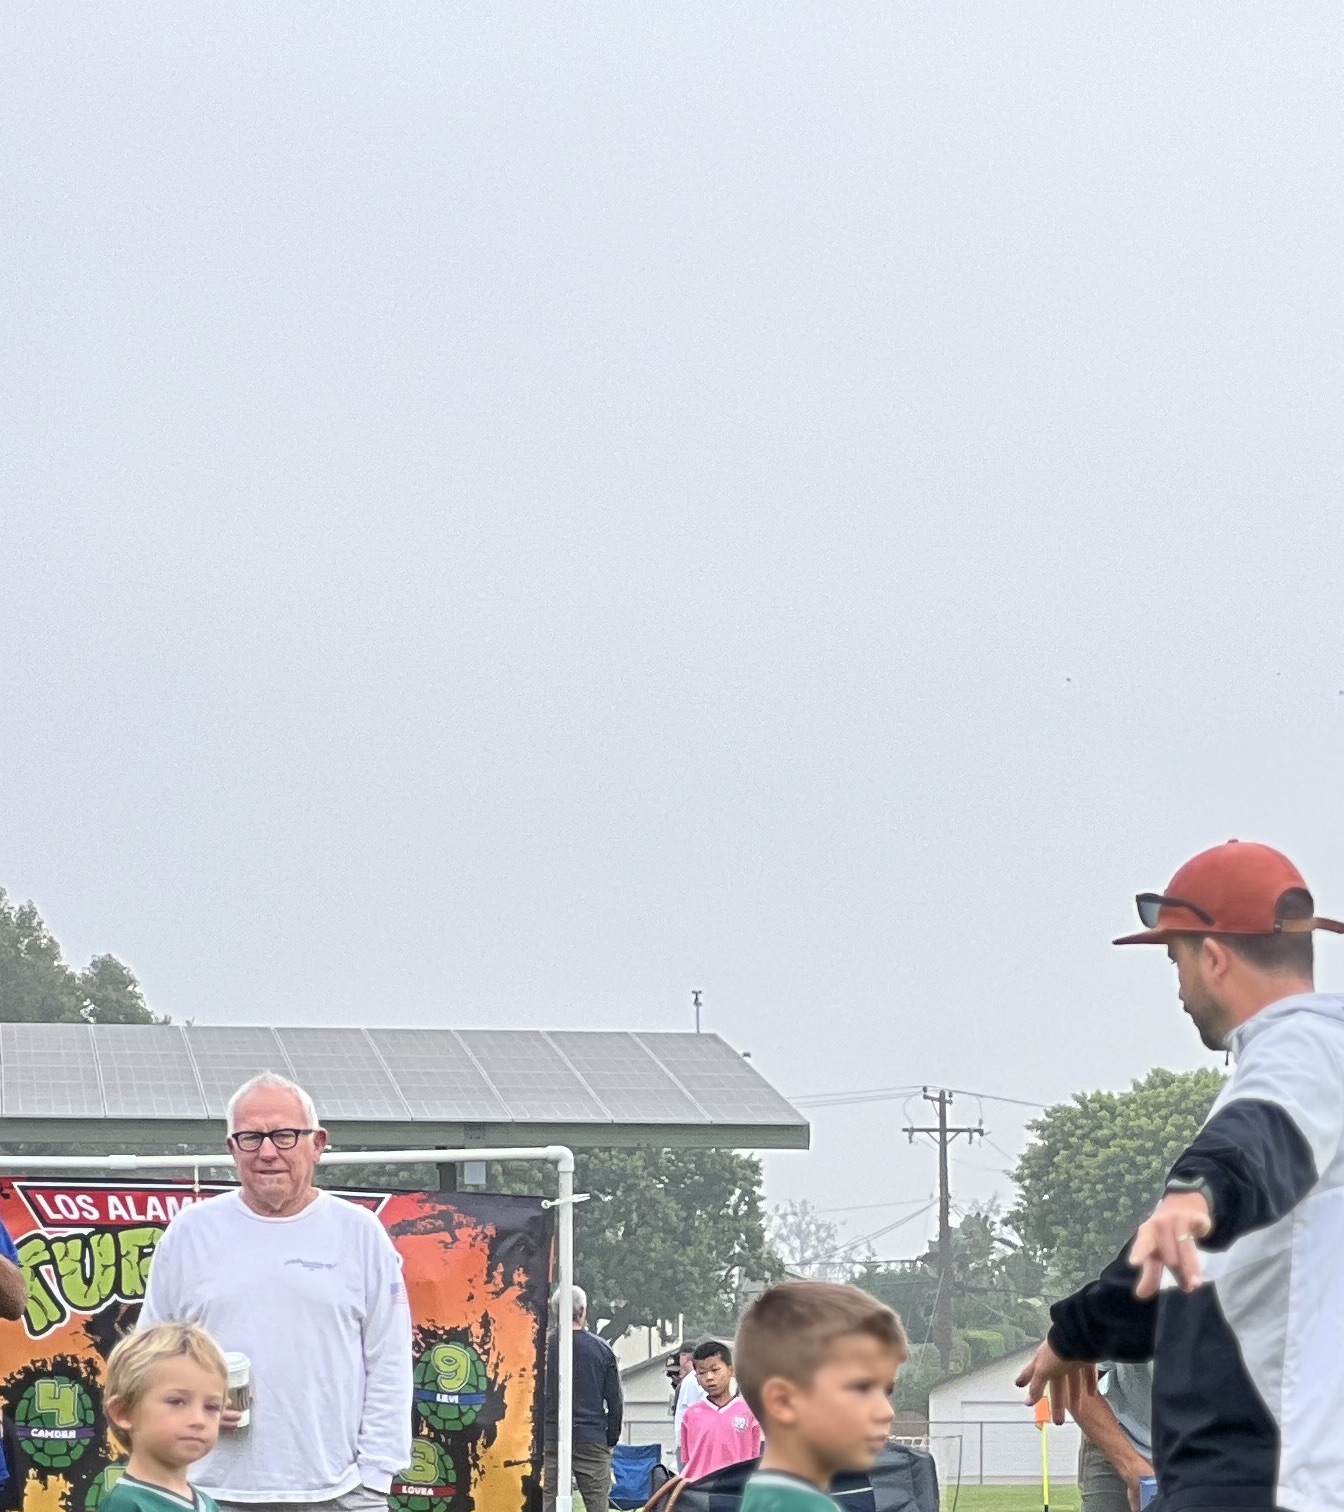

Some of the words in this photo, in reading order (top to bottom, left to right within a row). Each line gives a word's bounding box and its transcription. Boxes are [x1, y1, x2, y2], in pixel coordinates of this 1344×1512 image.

[35, 1193, 99, 1220] LOS
[107, 1194, 200, 1221] ALAM
[431, 1344, 470, 1392] 9
[36, 1380, 78, 1427] 4
[30, 1428, 77, 1439] CAMDEN
